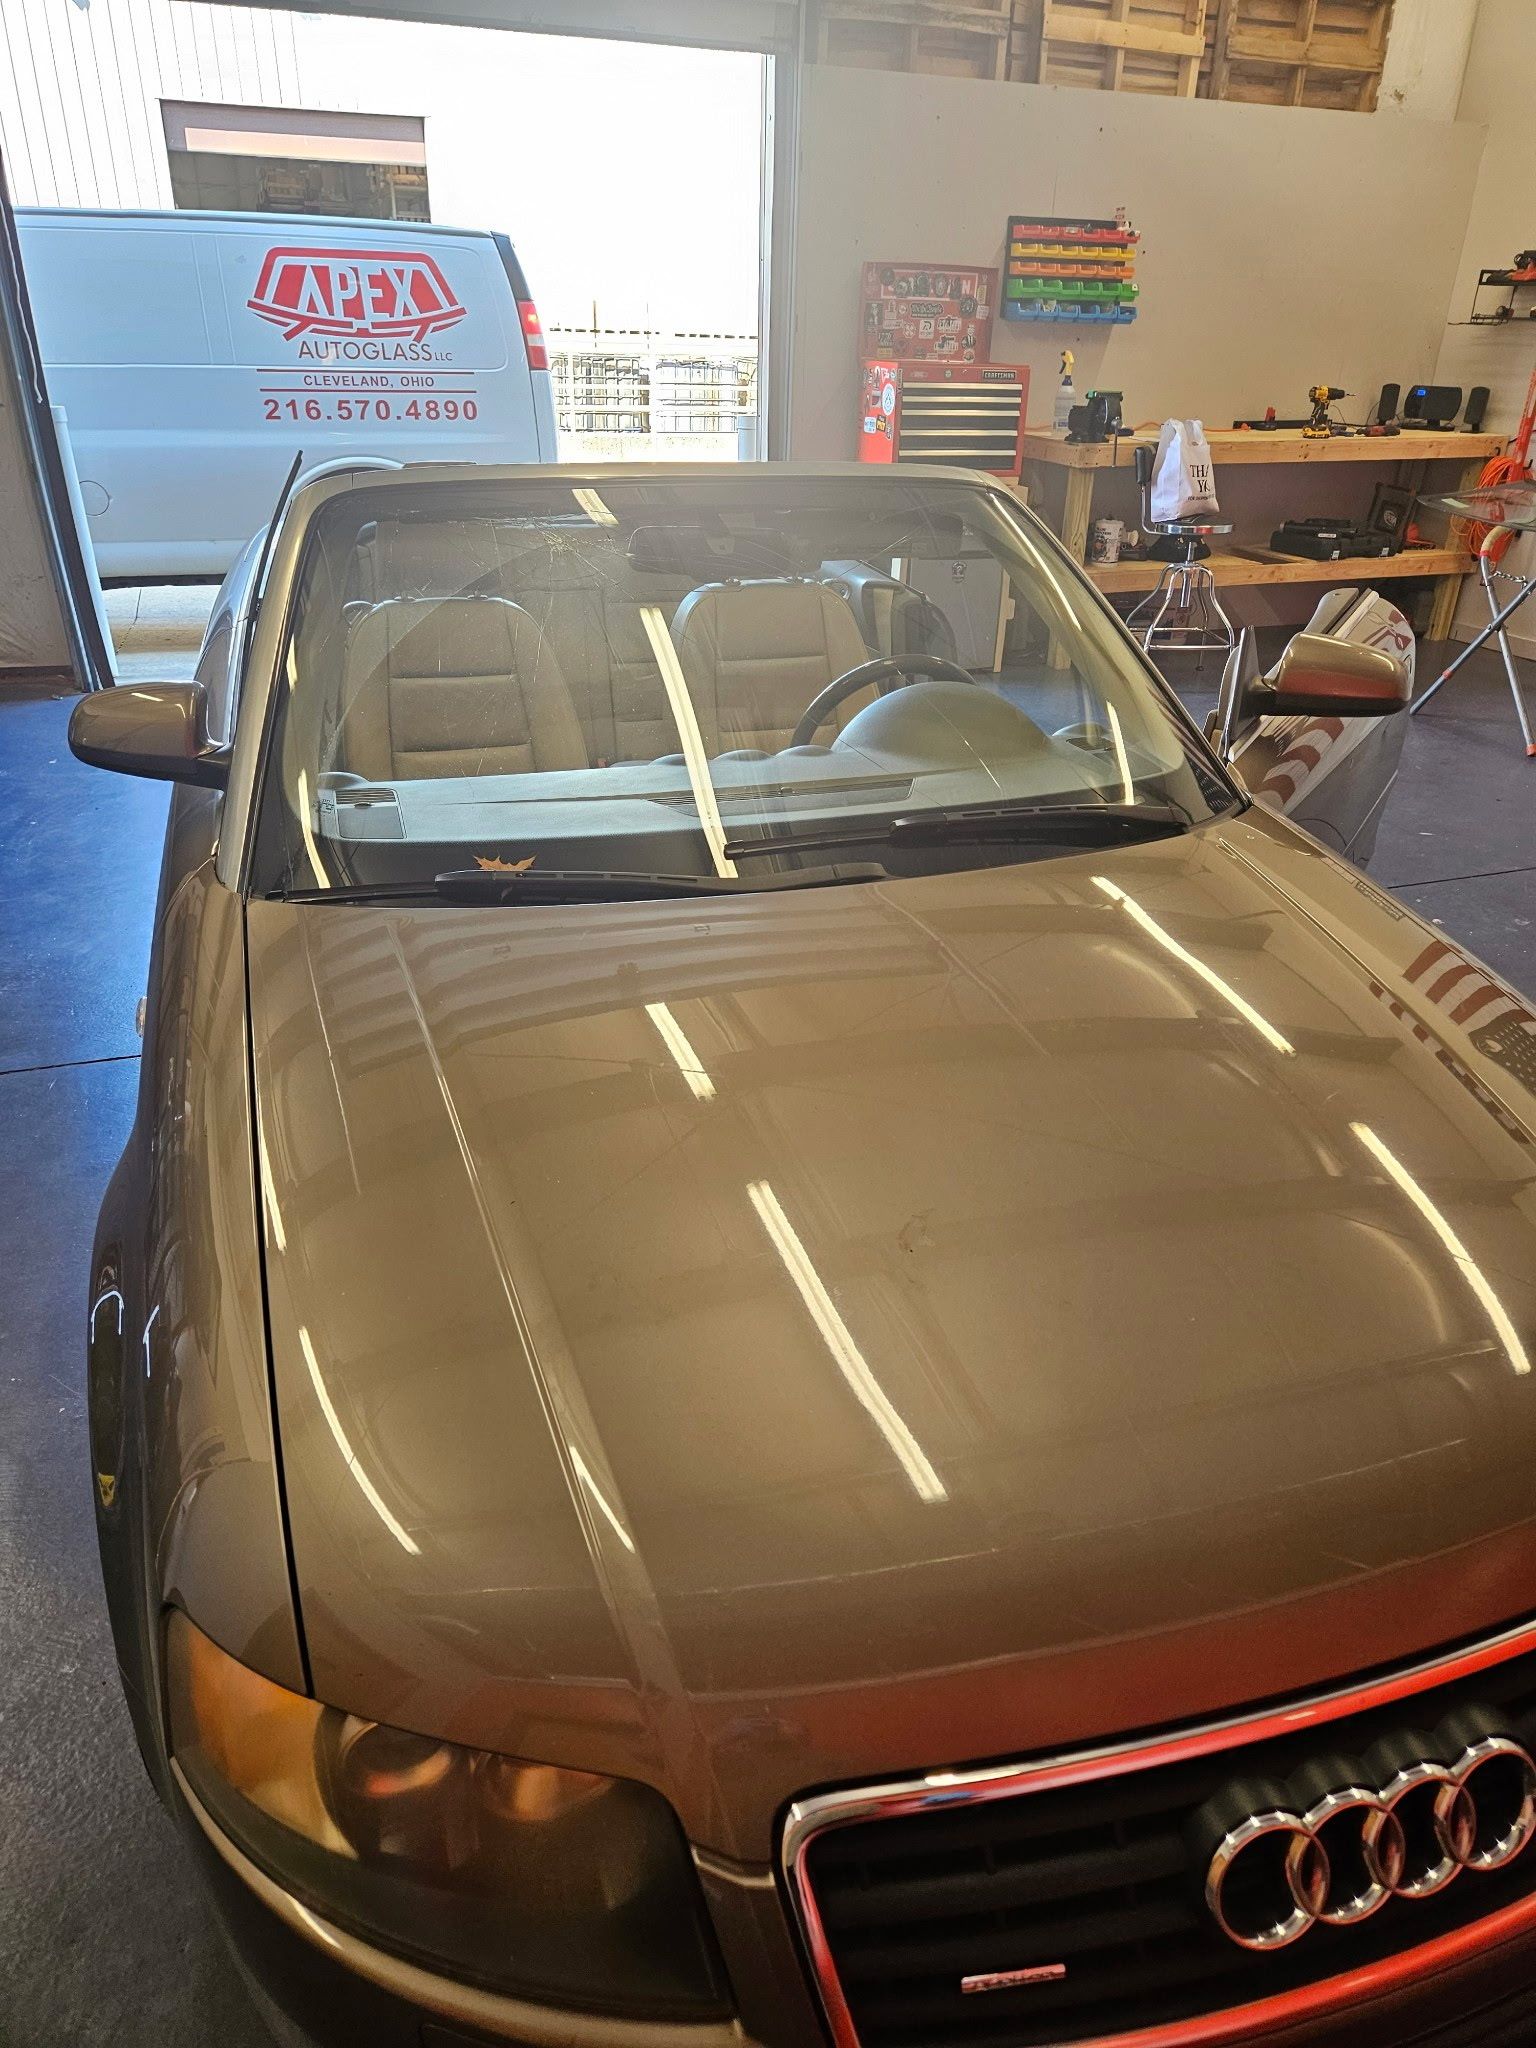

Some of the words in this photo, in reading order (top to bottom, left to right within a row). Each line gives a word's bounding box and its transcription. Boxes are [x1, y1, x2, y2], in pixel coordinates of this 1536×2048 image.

[297, 264, 422, 321] APEX
[298, 340, 433, 361] AUTOGLASS
[434, 352, 453, 361] LLC
[303, 375, 394, 388] CLEVELAND,
[400, 376, 435, 387] OHIO
[263, 399, 478, 421] 216.570.4890
